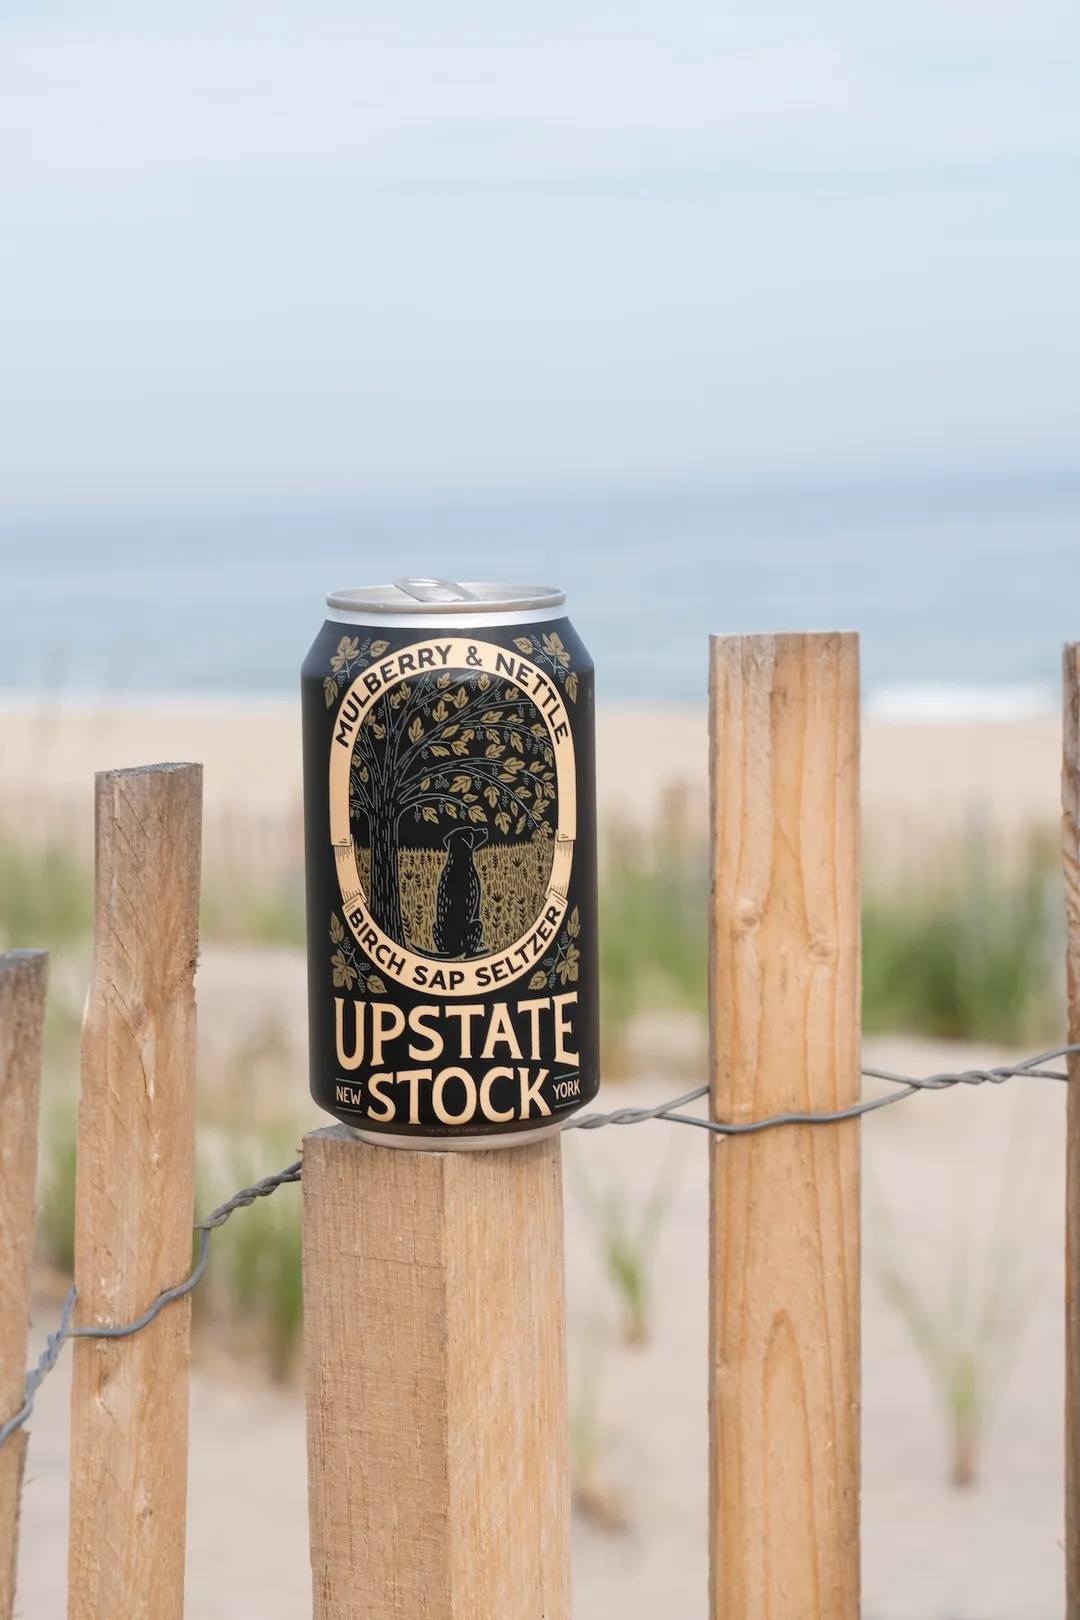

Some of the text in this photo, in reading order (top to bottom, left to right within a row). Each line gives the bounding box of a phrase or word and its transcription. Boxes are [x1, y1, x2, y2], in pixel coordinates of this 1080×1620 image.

[335, 644, 569, 748] MULBERRY & NETTLE
[348, 905, 562, 990] BIRCH SAP SELTZER
[334, 991, 580, 1071] UPSTATE
[336, 1086, 362, 1105] NEW
[367, 1066, 552, 1125] STOCK
[553, 1079, 581, 1100] YORK
